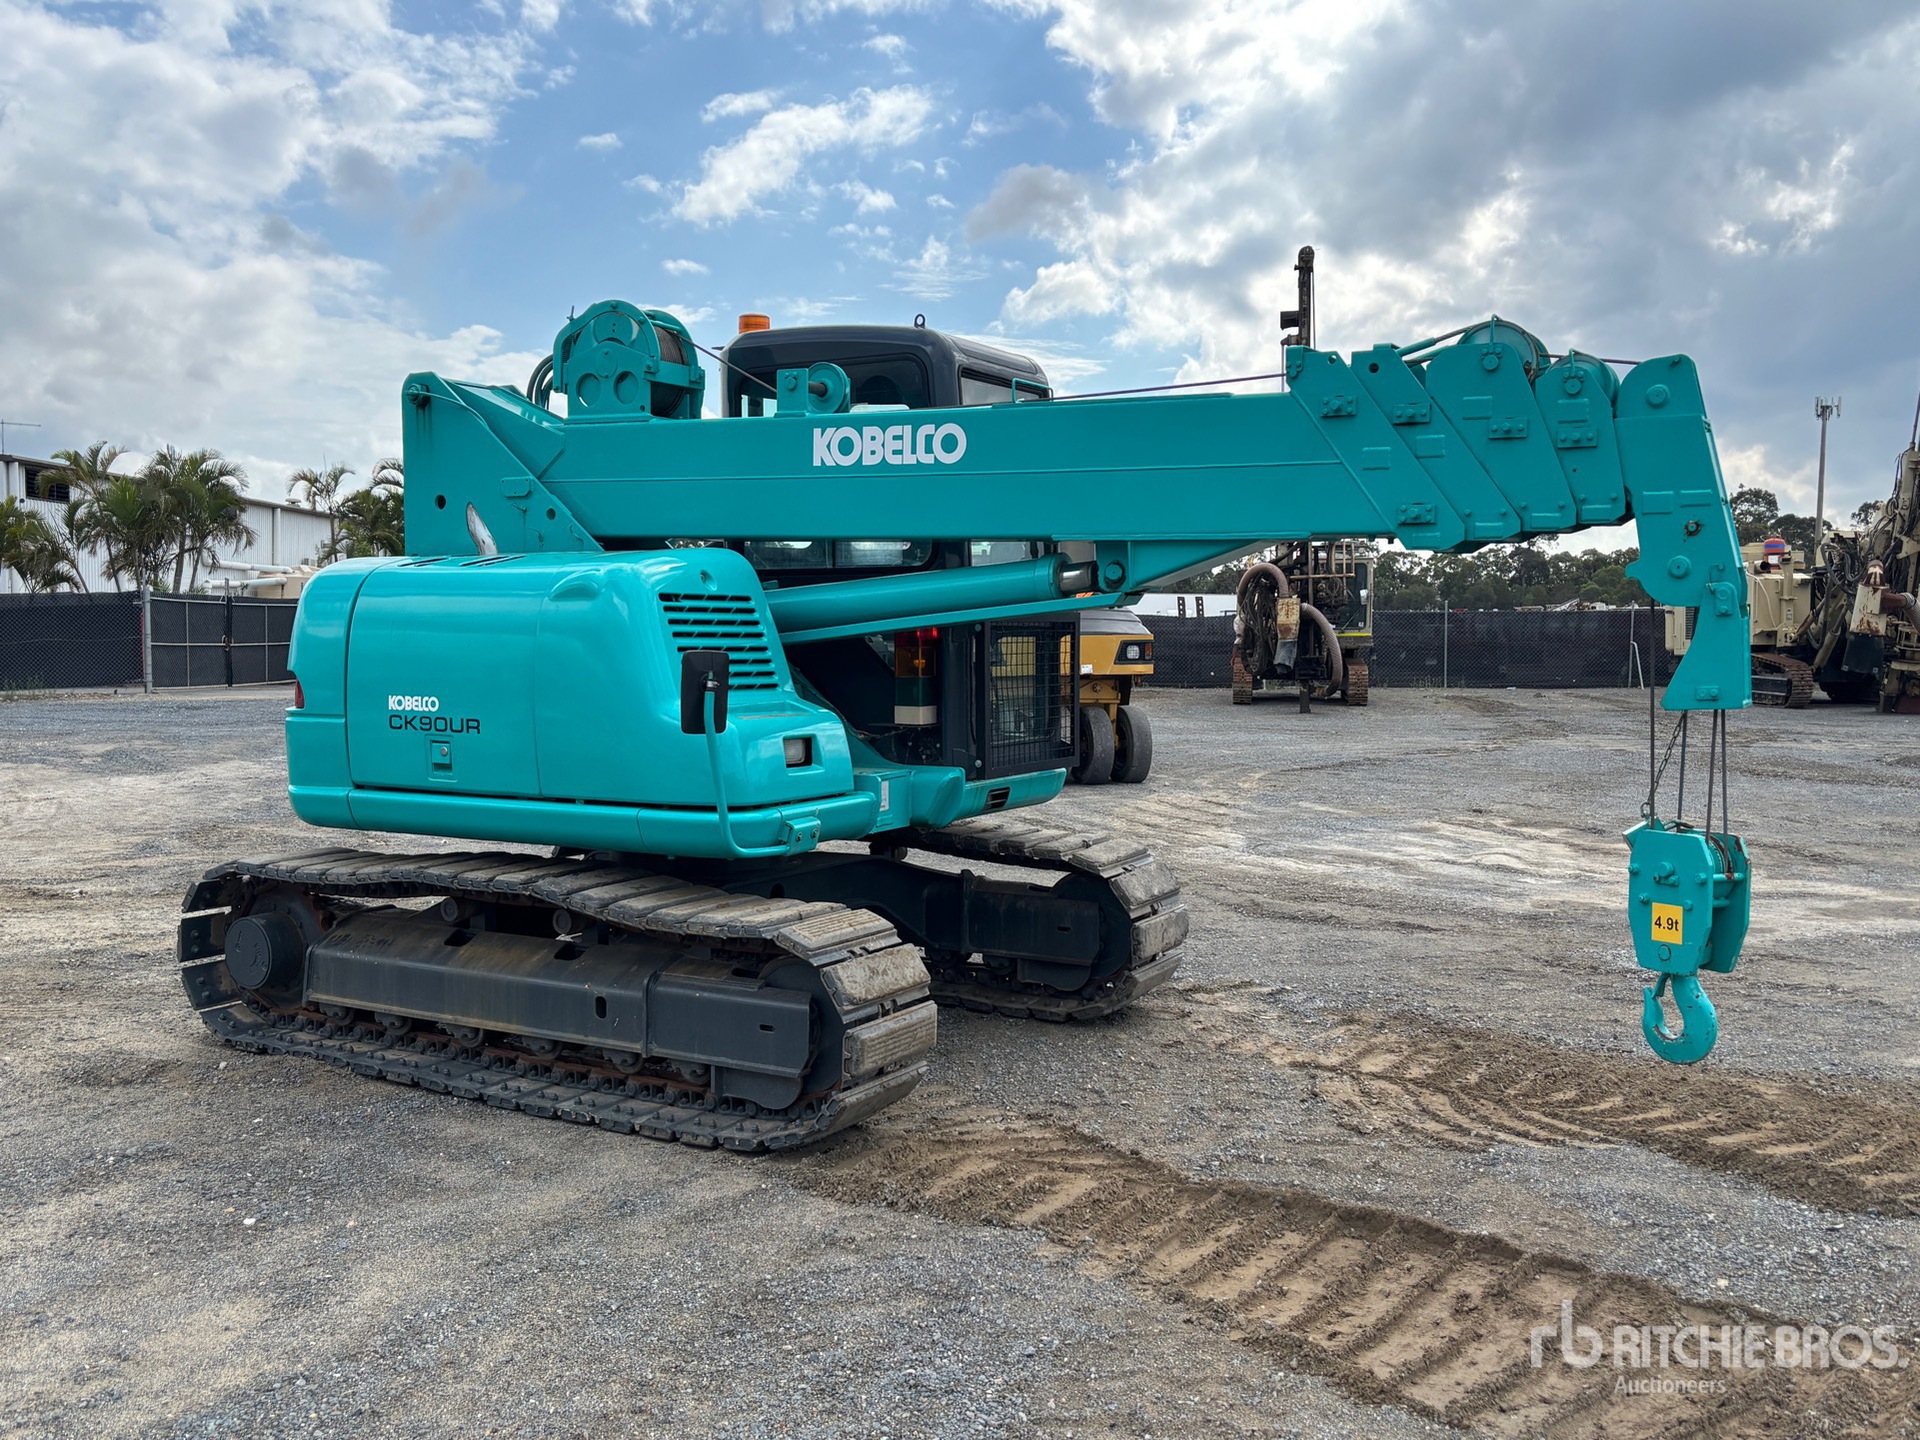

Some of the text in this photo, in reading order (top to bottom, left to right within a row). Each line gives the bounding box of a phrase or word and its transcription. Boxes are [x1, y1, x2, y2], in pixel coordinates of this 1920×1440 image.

[813, 423, 967, 467] KOBELCO
[388, 695, 440, 712] KOBELCO
[388, 714, 481, 734] CK90UR
[1654, 915, 1679, 932] 4.9t
